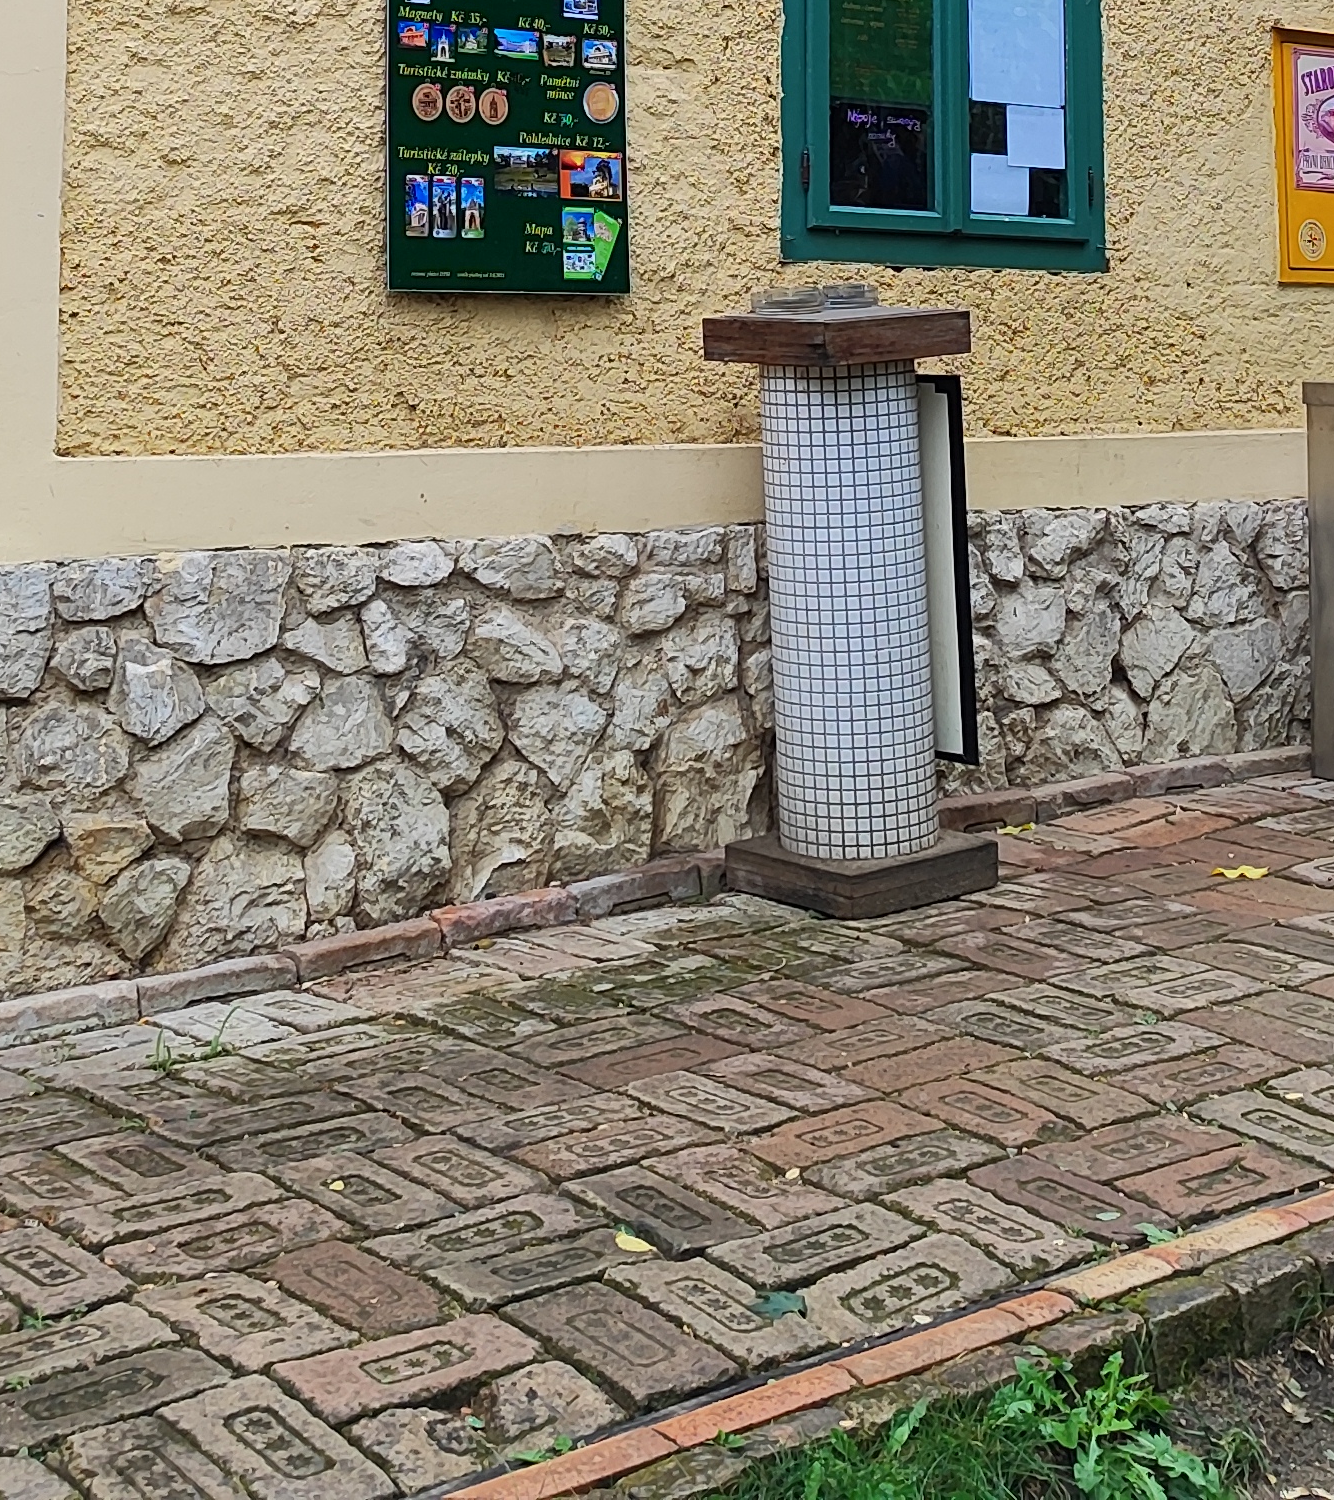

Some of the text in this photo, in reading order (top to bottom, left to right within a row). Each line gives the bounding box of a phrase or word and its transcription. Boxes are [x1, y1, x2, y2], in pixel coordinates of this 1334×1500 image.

[398, 5, 444, 24] Magnety
[450, 10, 465, 22] Kč
[518, 16, 532, 29] Kč
[583, 22, 597, 35] Kč
[397, 63, 449, 79] Turistické
[450, 67, 490, 84] známky
[519, 131, 571, 146] Pohlednice
[575, 133, 589, 147] Kč
[397, 146, 490, 166] Turistické nálepky
[427, 162, 442, 175] Kč
[524, 222, 553, 238] Mapa
[525, 240, 539, 253] Kč
